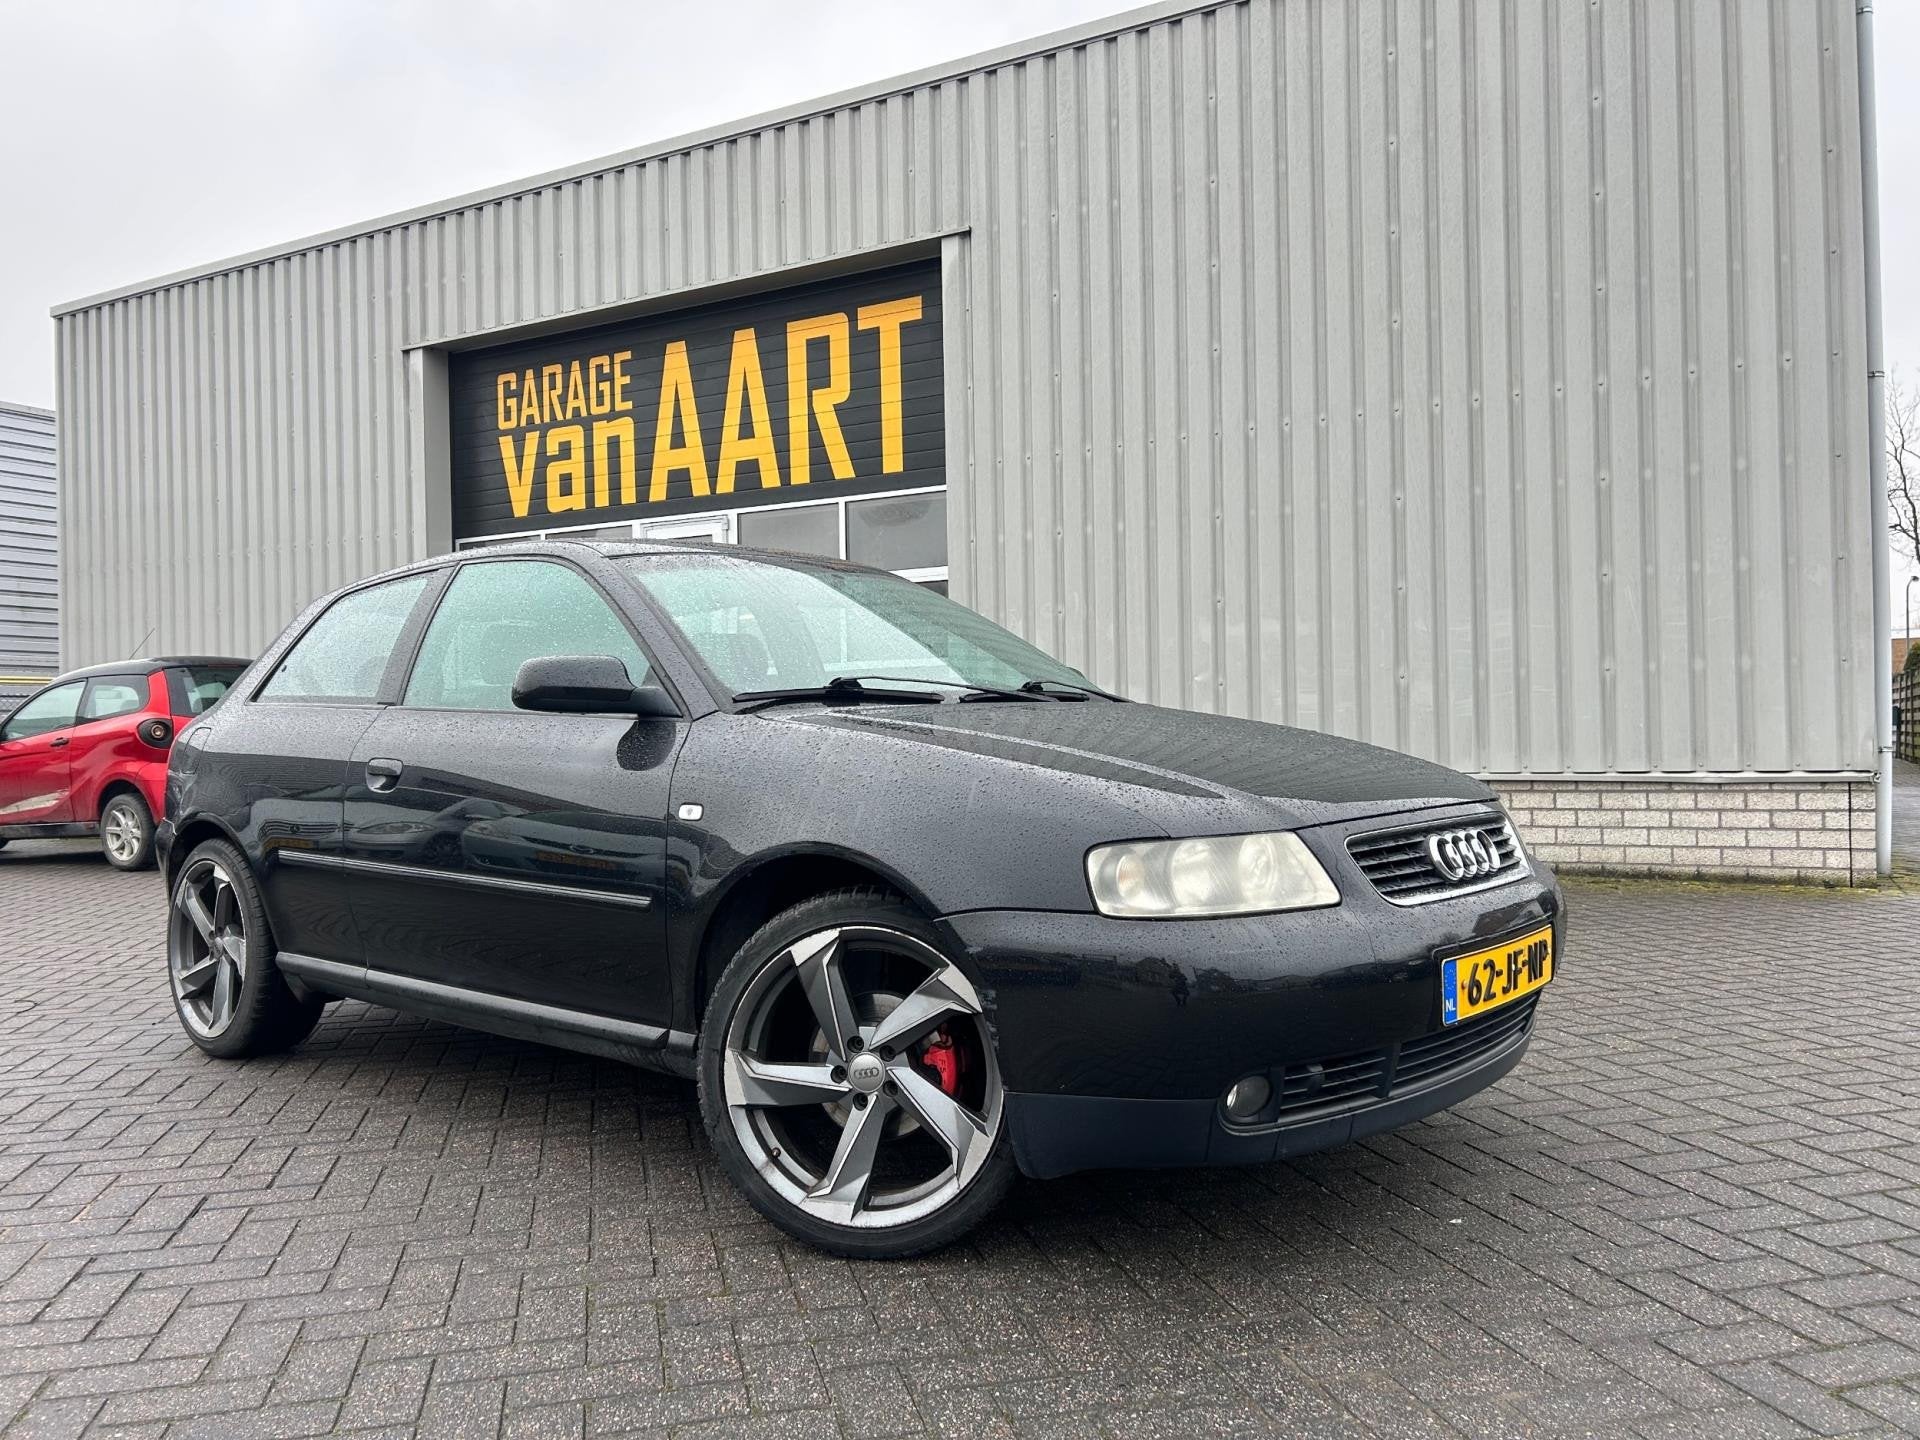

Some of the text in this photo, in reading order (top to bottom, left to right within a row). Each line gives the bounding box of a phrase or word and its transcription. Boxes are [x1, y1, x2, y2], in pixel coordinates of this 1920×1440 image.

[497, 350, 633, 430] GARAGE
[498, 296, 923, 518] van AART
[1444, 998, 1456, 1013] NL
[1467, 939, 1549, 1007] 62-JF-NP
